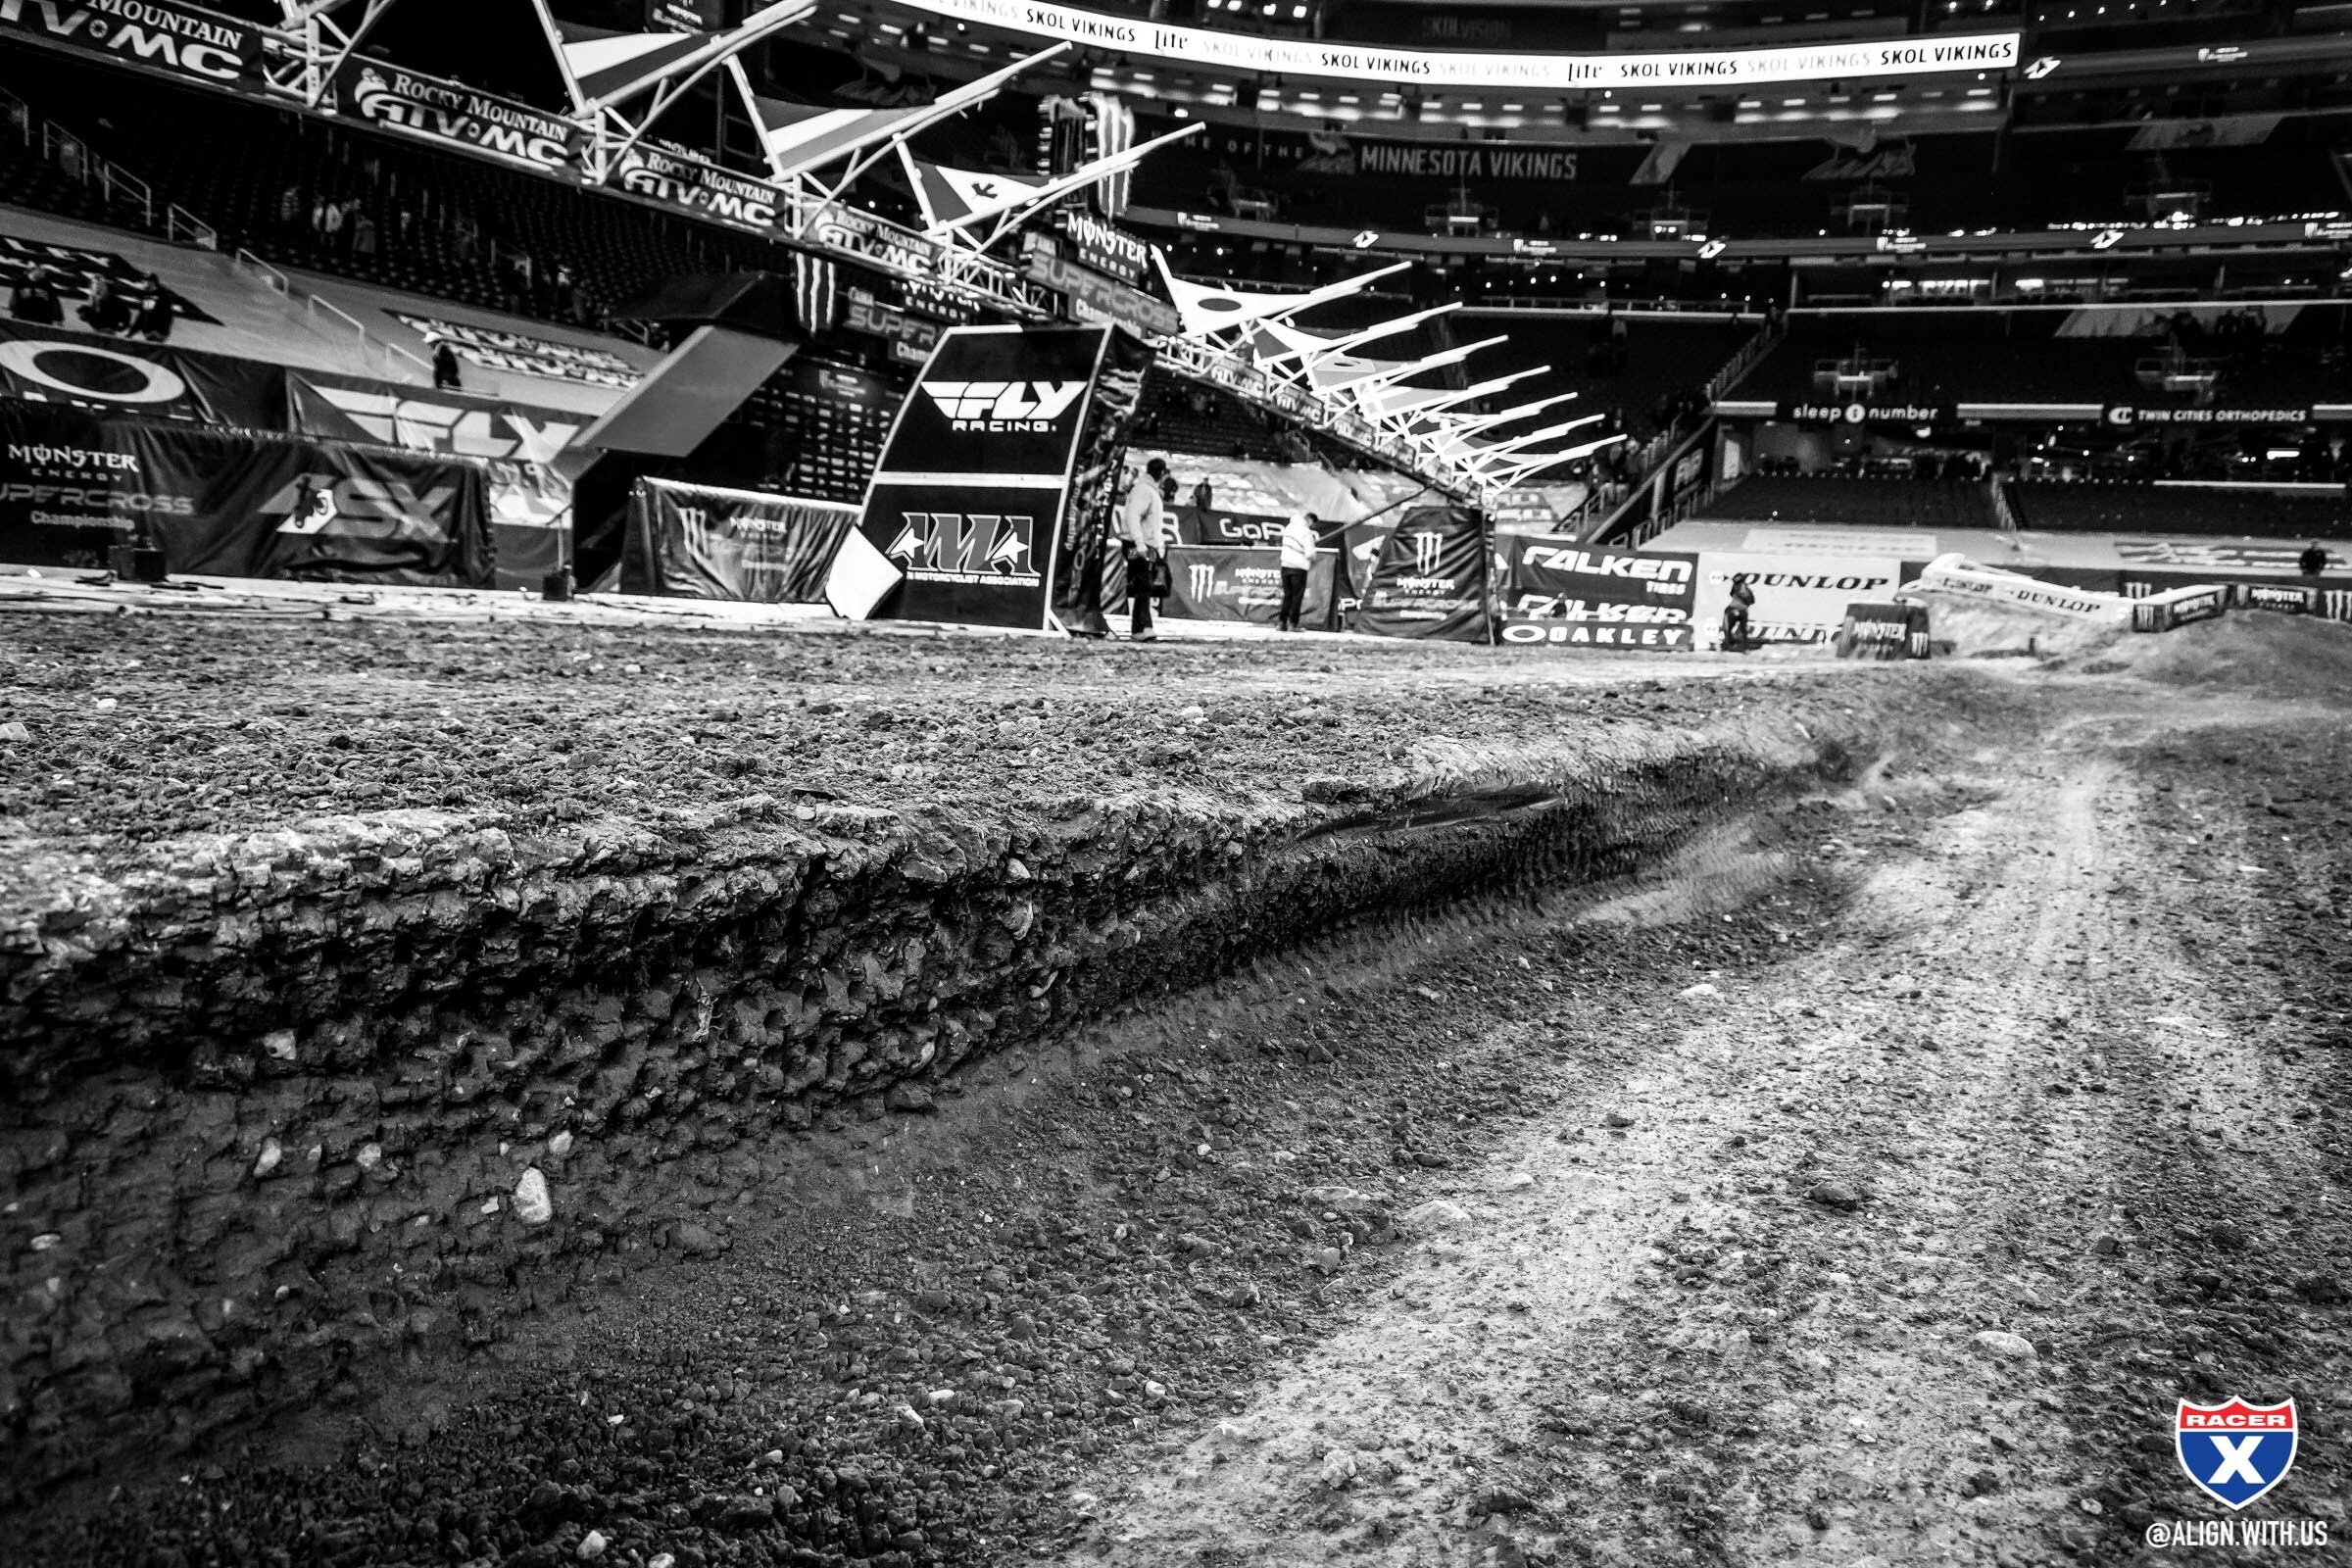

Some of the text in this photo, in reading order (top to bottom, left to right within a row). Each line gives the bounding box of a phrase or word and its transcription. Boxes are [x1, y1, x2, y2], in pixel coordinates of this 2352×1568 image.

[1027, 9, 1136, 43] SKOL VIKINGS
[1321, 53, 1430, 75] SKOL VIKINGS
[1881, 42, 2013, 66] SKOL VIKINGS
[1620, 60, 1738, 78] SKOL VIKINGS
[393, 73, 567, 143] ROCKY MOUNTAIN
[1262, 142, 1304, 160] THE
[1360, 145, 1578, 180] MINNESOTA VIKINGS
[647, 152, 777, 206] ROCKY MOUNTAIN
[1066, 212, 1148, 270] MONSTER
[1079, 247, 1137, 279] ENERGY
[920, 381, 1089, 420] FLY
[1792, 403, 1938, 423] sleep number
[2137, 409, 2172, 422] TWIN
[2173, 409, 2213, 422] CITIES
[2215, 409, 2307, 422] ORTHOPEDICS
[8, 443, 140, 472] MONSTER
[30, 467, 122, 482] ENERGY
[0, 482, 194, 515] PERCROSS
[30, 510, 136, 532] Championship
[1234, 567, 1281, 579] MONSTE
[1522, 545, 1693, 583] FALKEN
[915, 571, 979, 585] MOTORCYCLIST
[979, 576, 1041, 588] ASSOCIATION
[1741, 572, 1888, 590] DUNLOP
[2017, 589, 2101, 613] DUNLOP
[1548, 626, 1682, 646] OAKLEY
